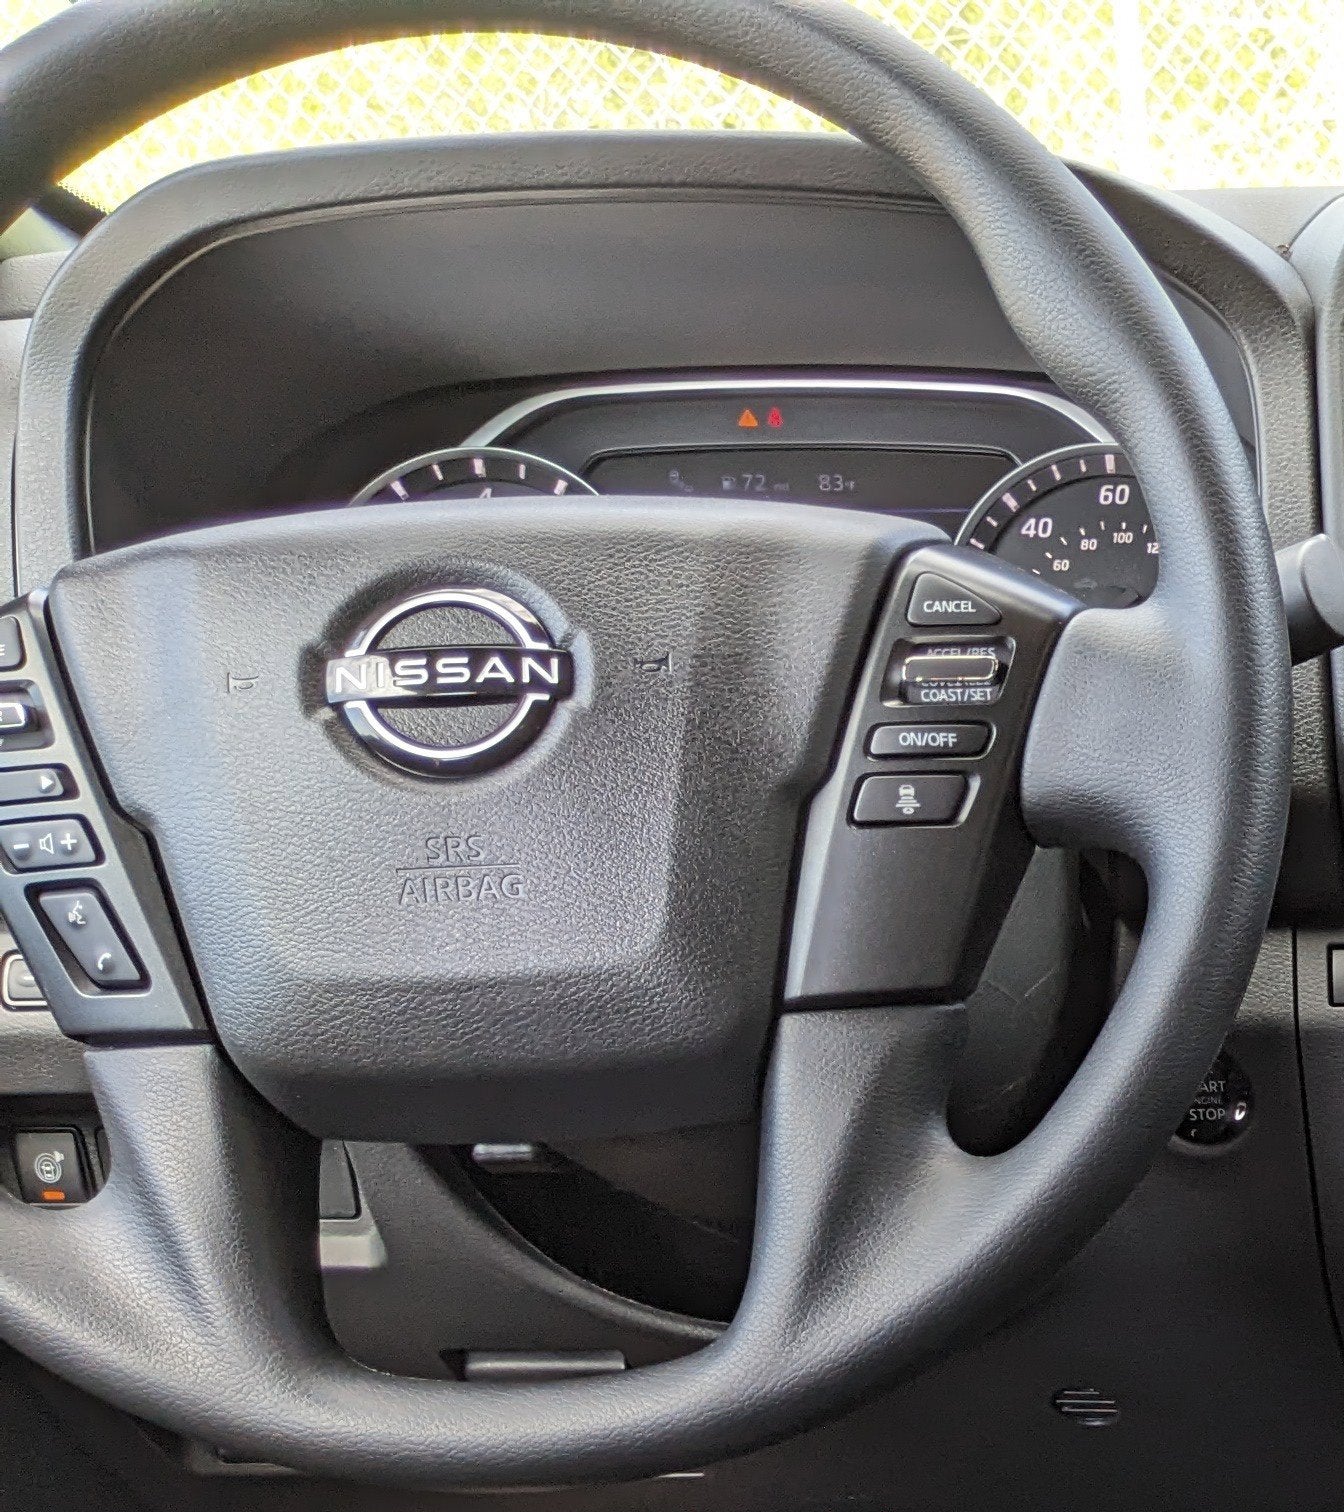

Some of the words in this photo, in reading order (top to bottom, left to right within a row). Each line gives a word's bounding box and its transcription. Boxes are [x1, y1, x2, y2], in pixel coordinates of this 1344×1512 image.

[1099, 484, 1130, 505] 60
[1021, 517, 1052, 538] 40
[1080, 539, 1097, 551] 80
[1112, 532, 1133, 544] 100
[1147, 542, 1160, 554] 12
[1053, 559, 1069, 571] 60
[923, 600, 976, 614] CANCEL
[334, 655, 560, 694] NISSAN
[920, 688, 993, 703] COAST/SET
[899, 732, 957, 748] ON/OFF
[425, 833, 485, 864] SRS
[399, 872, 528, 904] AIRBAG
[1199, 1081, 1226, 1093] ART
[1189, 1108, 1226, 1121] STOP
